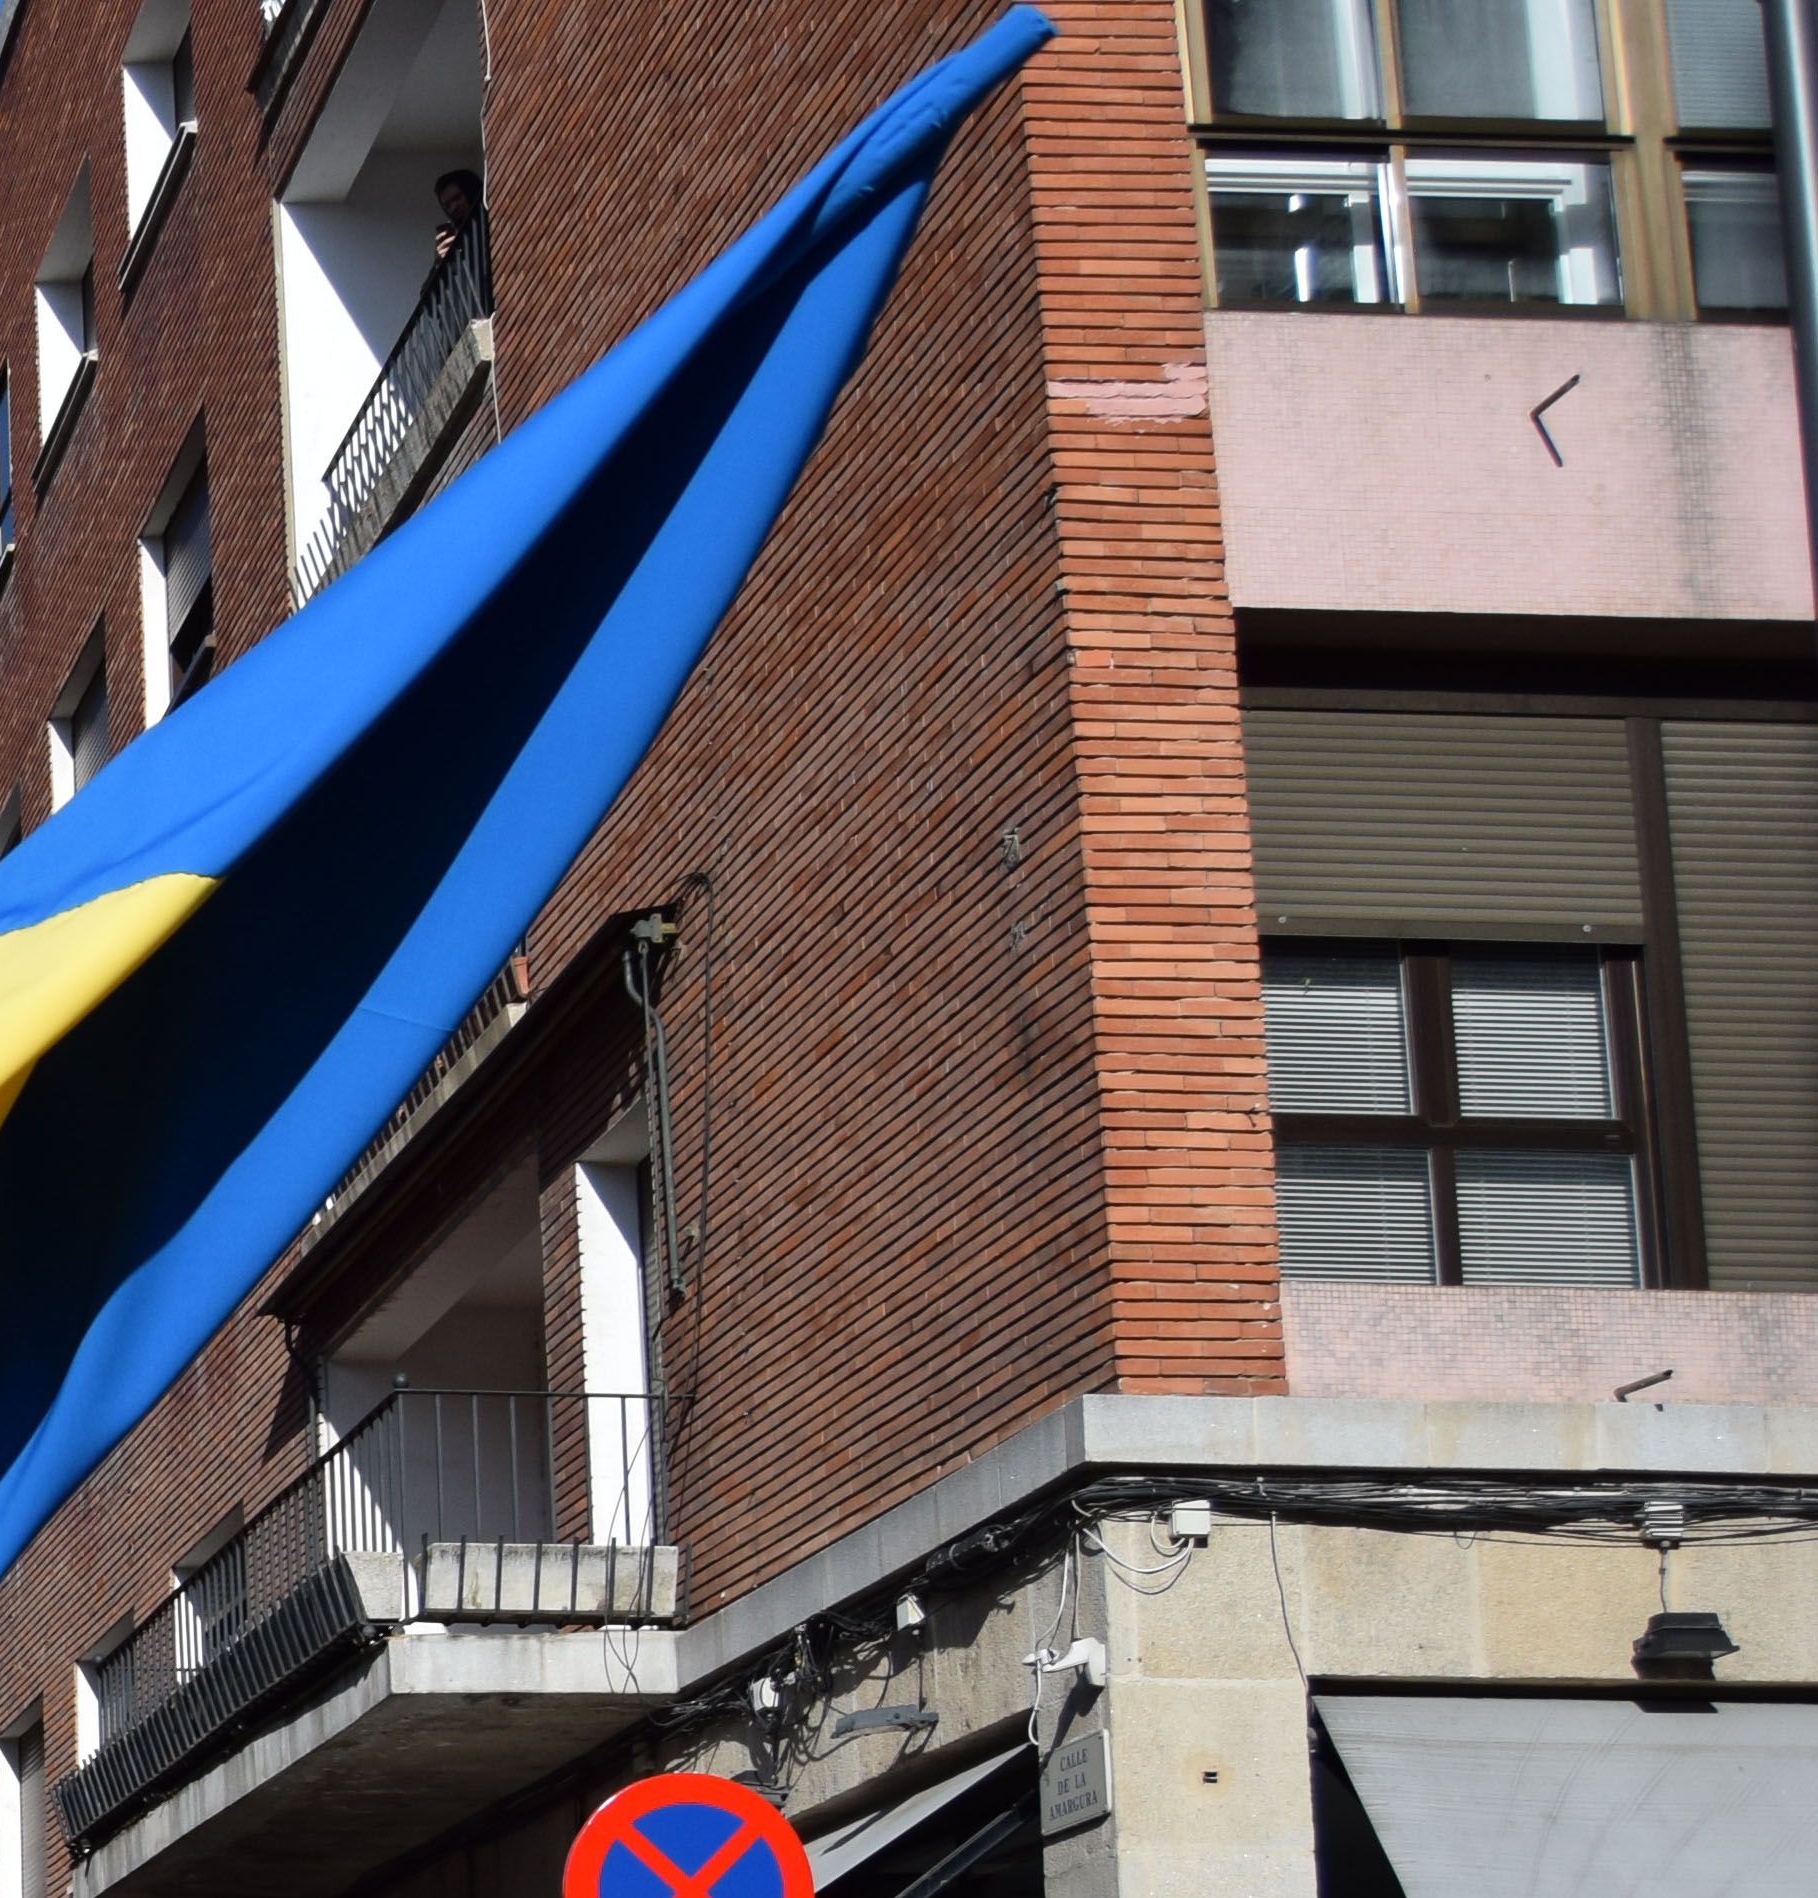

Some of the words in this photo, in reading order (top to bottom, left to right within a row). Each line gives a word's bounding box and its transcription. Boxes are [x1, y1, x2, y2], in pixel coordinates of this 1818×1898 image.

[1059, 1749, 1087, 1772] CALLE
[1057, 1779, 1069, 1795] DE
[1075, 1772, 1086, 1788] LA
[1049, 1790, 1098, 1819] AMARGURA
